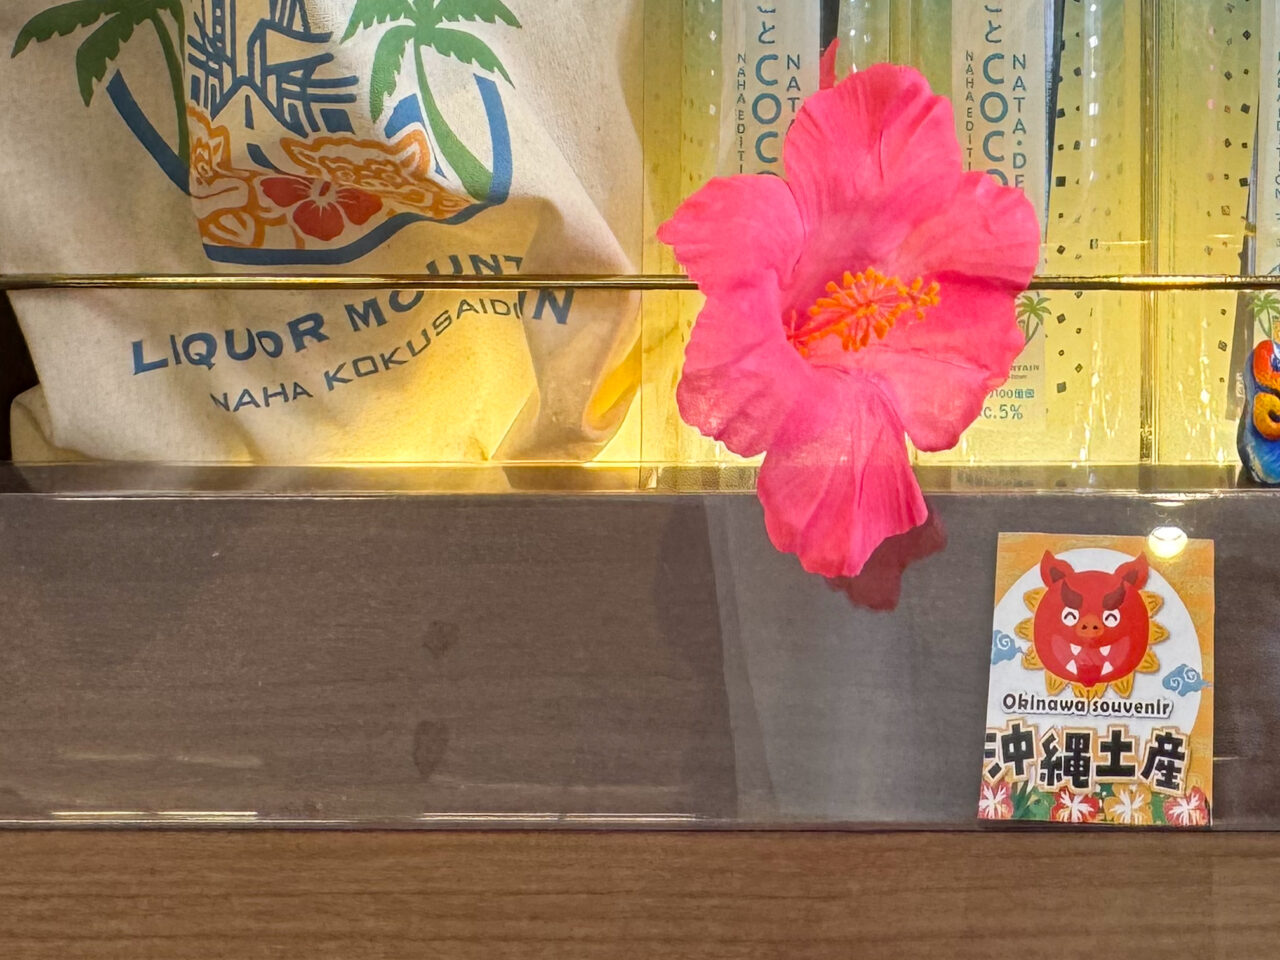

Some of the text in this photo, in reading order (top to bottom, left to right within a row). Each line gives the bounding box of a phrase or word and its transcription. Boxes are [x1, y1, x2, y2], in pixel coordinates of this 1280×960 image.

[751, 54, 783, 177] COC
[130, 313, 330, 376] LIQUOR
[210, 381, 313, 413] NAHA
[1002, 692, 1171, 716] Okinawa souvenir
[984, 722, 1187, 791] 沖縄土産
